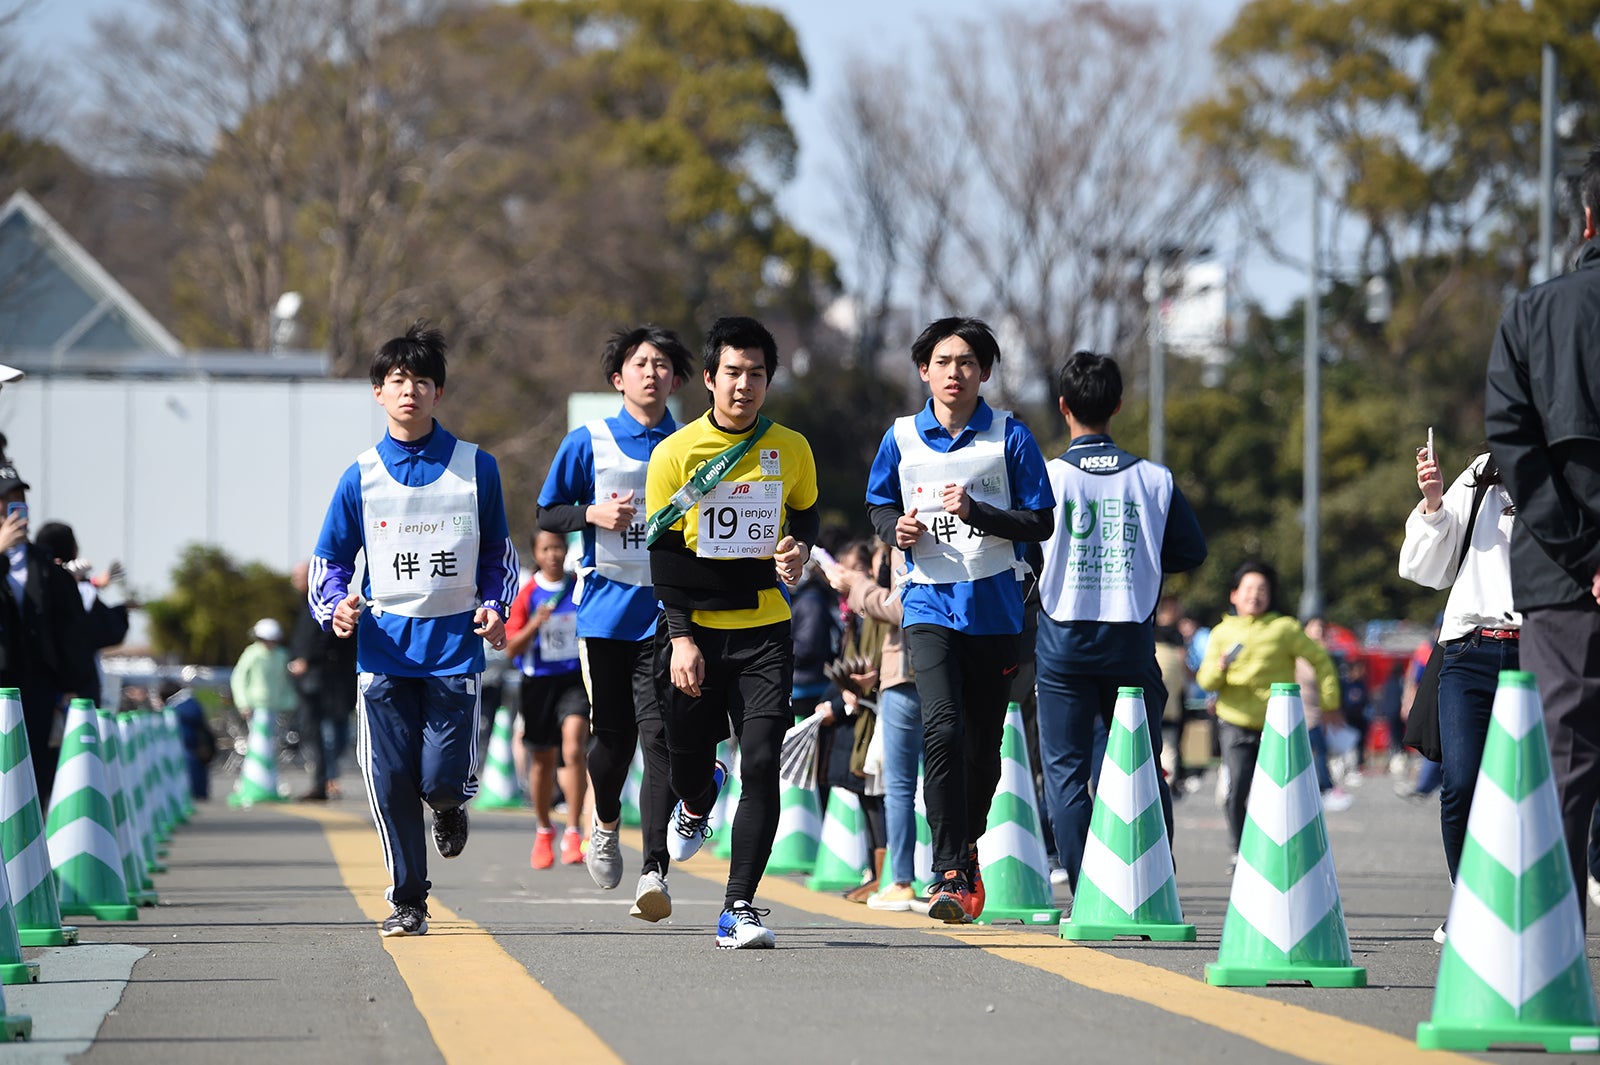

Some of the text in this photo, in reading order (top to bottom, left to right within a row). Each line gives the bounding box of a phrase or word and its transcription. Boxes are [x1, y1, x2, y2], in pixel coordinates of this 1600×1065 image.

[1080, 455, 1119, 469] NSSU
[732, 484, 750, 495] JTB
[1103, 499, 1141, 519] 日本
[703, 506, 738, 540] 19
[748, 522, 775, 541] 6区
[713, 545, 735, 554] チーム
[392, 550, 459, 580] 伴走
